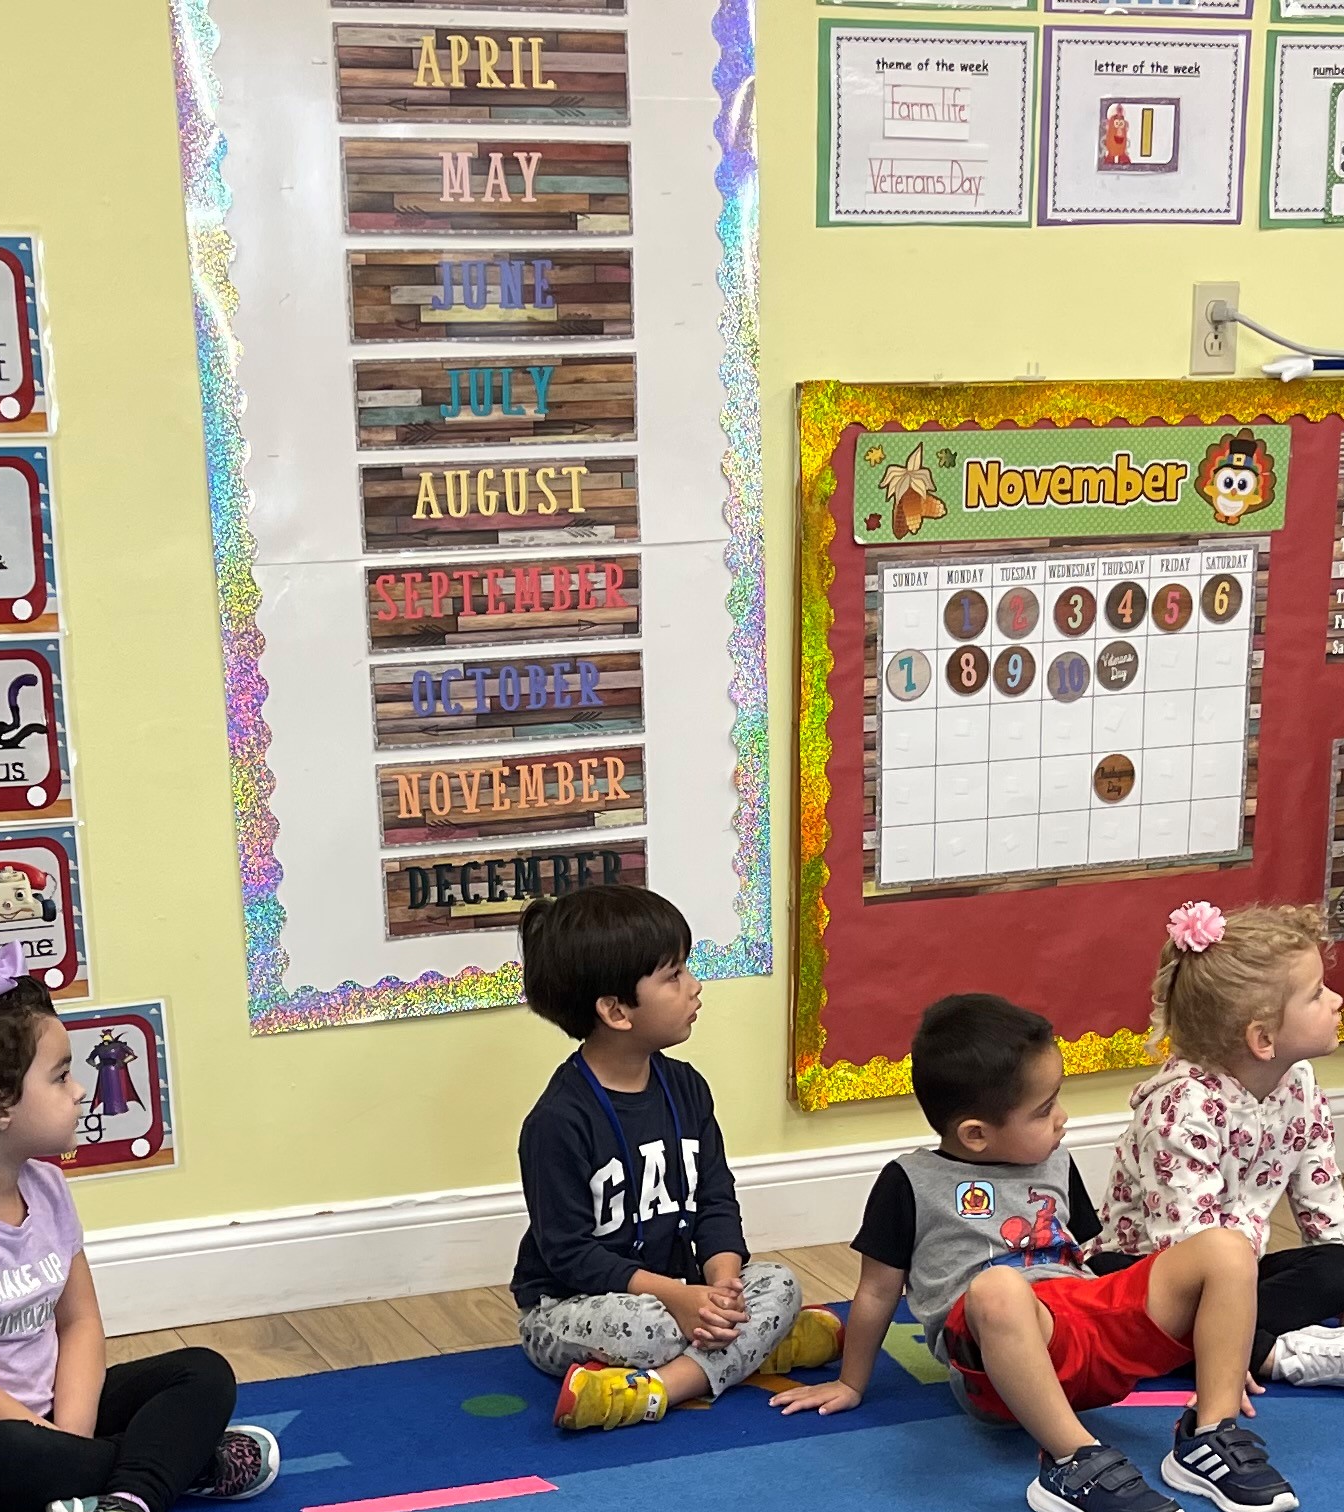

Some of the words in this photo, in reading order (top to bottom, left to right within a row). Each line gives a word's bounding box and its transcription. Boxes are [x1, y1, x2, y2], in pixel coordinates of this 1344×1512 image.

[413, 35, 555, 90] APRIL
[875, 57, 912, 72] theme
[917, 58, 930, 71] of
[936, 58, 955, 72] the
[960, 59, 989, 72] week
[1094, 61, 1128, 74] letter
[1132, 62, 1146, 73] of
[1150, 62, 1169, 75] the
[1173, 62, 1201, 75] week
[891, 85, 937, 121] Farm
[942, 87, 968, 122] life
[437, 151, 542, 203] MAY
[869, 159, 946, 194] Veterans
[950, 160, 982, 207] Day
[431, 258, 553, 311] JUNE
[440, 366, 554, 420] JULY
[413, 466, 588, 520] AUGUST
[965, 455, 1187, 509] November
[892, 572, 929, 587] SUNDAY
[946, 568, 984, 584] MONDAY
[1000, 566, 1037, 581] TUESDAY
[1048, 562, 1096, 578] WEDNESDAY
[1102, 560, 1145, 575] THURSDAY
[1160, 557, 1191, 572] FRIDAY
[1205, 554, 1248, 570] SATURDAY
[375, 562, 628, 621] SEPTEMBER
[1117, 589, 1133, 623] 4
[1164, 591, 1181, 625] 5
[1213, 581, 1231, 615] 6
[959, 598, 974, 631] 1
[1009, 595, 1029, 630] 2
[1067, 594, 1083, 629] 3
[899, 656, 916, 692] 7
[960, 652, 977, 687] 8
[1007, 653, 1023, 688] 9
[1056, 657, 1085, 694] 10
[412, 660, 604, 718] OCTOBER
[396, 756, 631, 819] NOVEMBER
[406, 849, 622, 910] DECEMBER
[38, 1252, 65, 1284] UP
